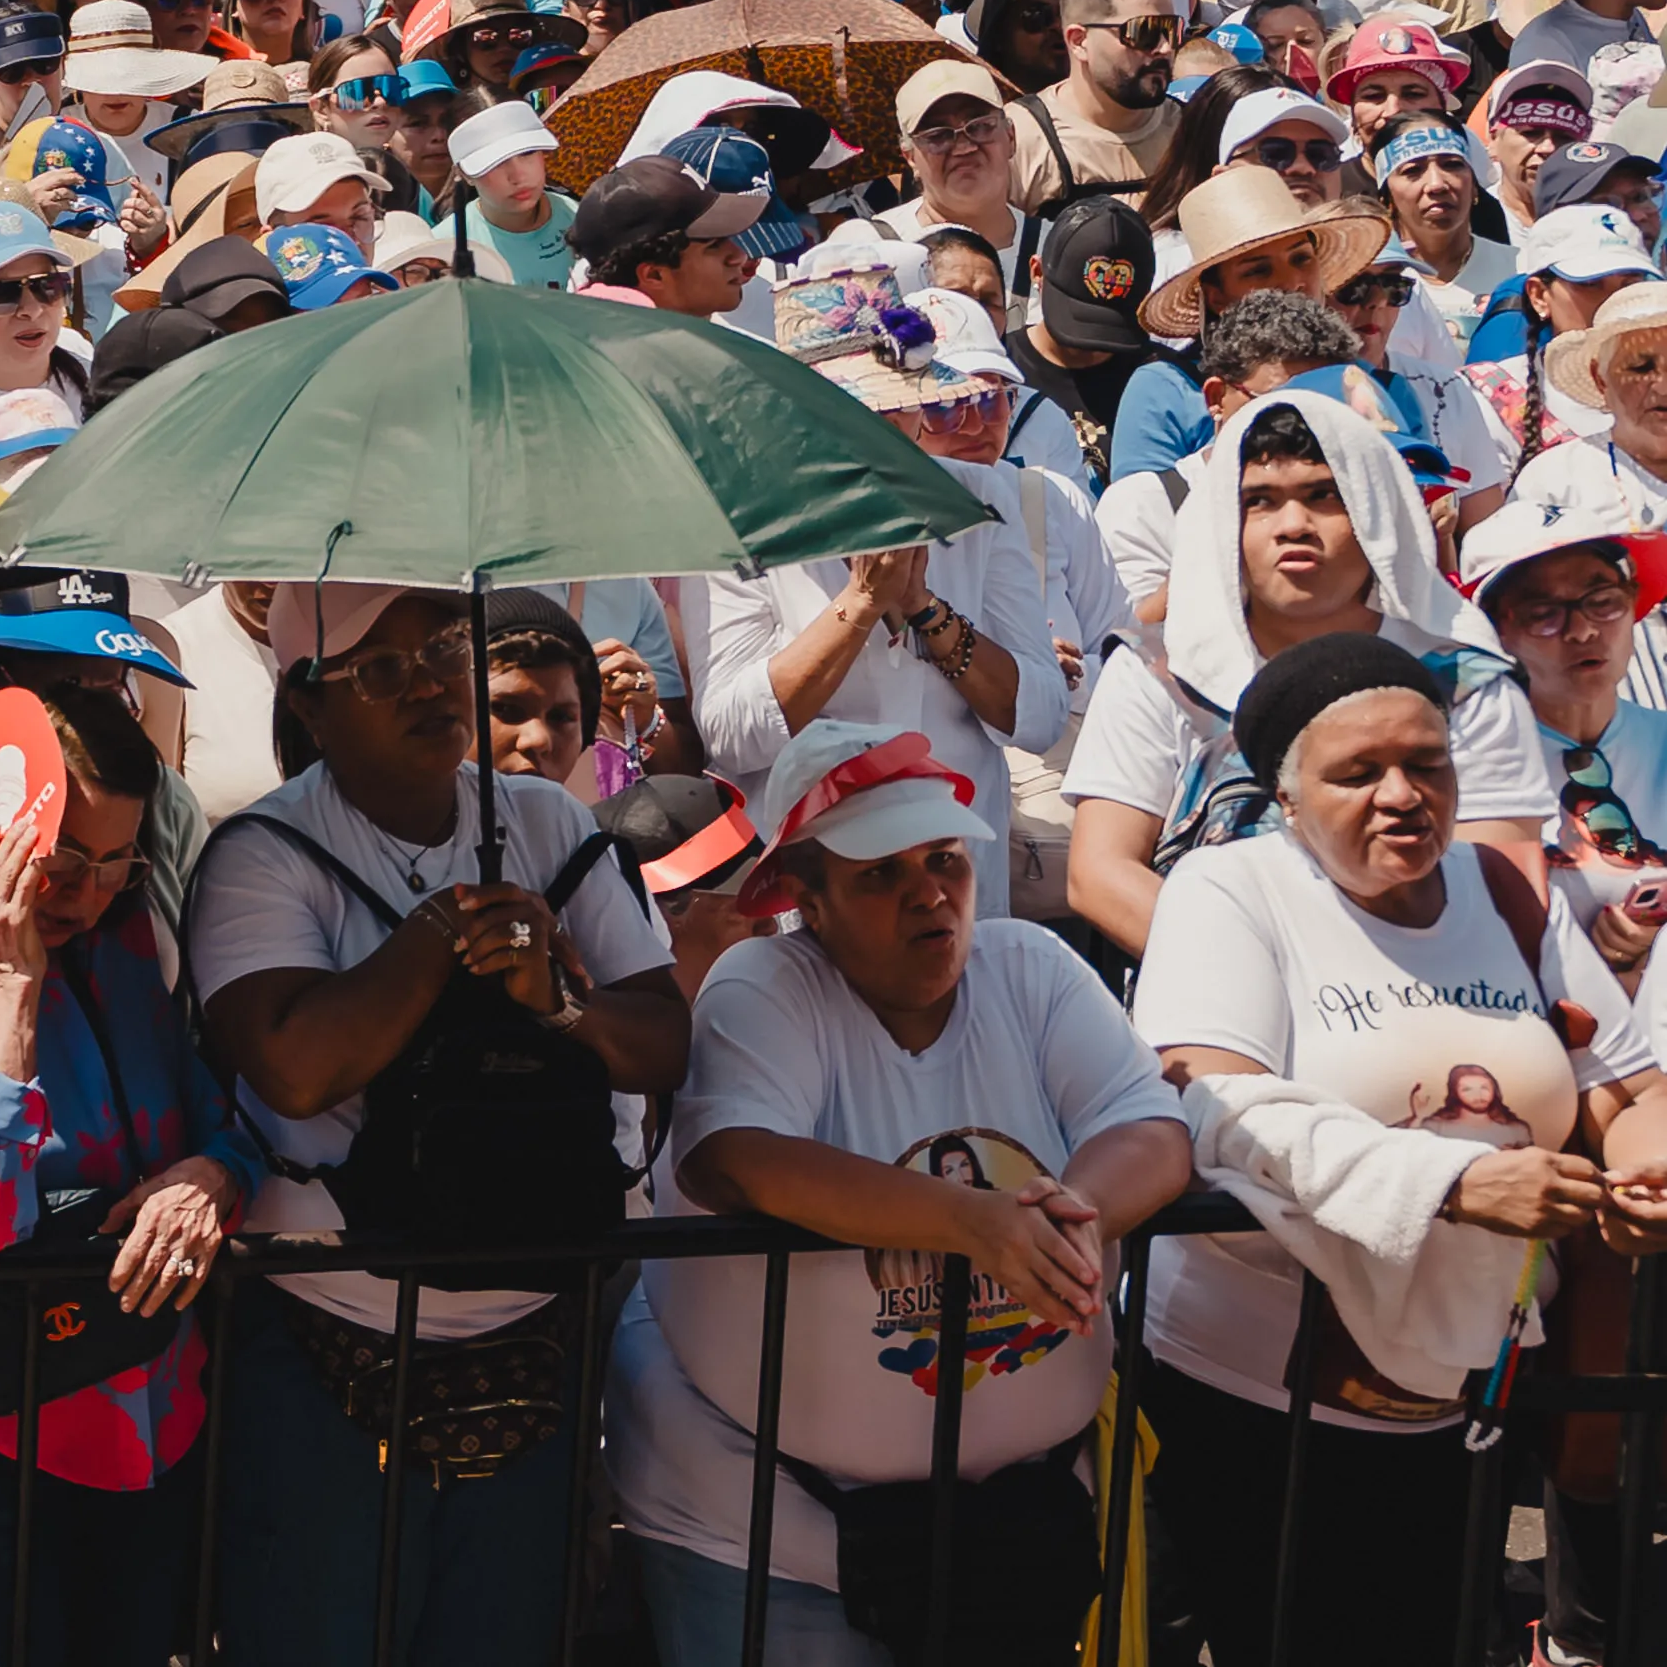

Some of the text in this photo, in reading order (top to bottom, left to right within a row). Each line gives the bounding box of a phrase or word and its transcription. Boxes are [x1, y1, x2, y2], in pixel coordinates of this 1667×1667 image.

[1498, 100, 1591, 130] Jesús
[57, 576, 90, 605] LA
[876, 1278, 942, 1317] JESÚS
